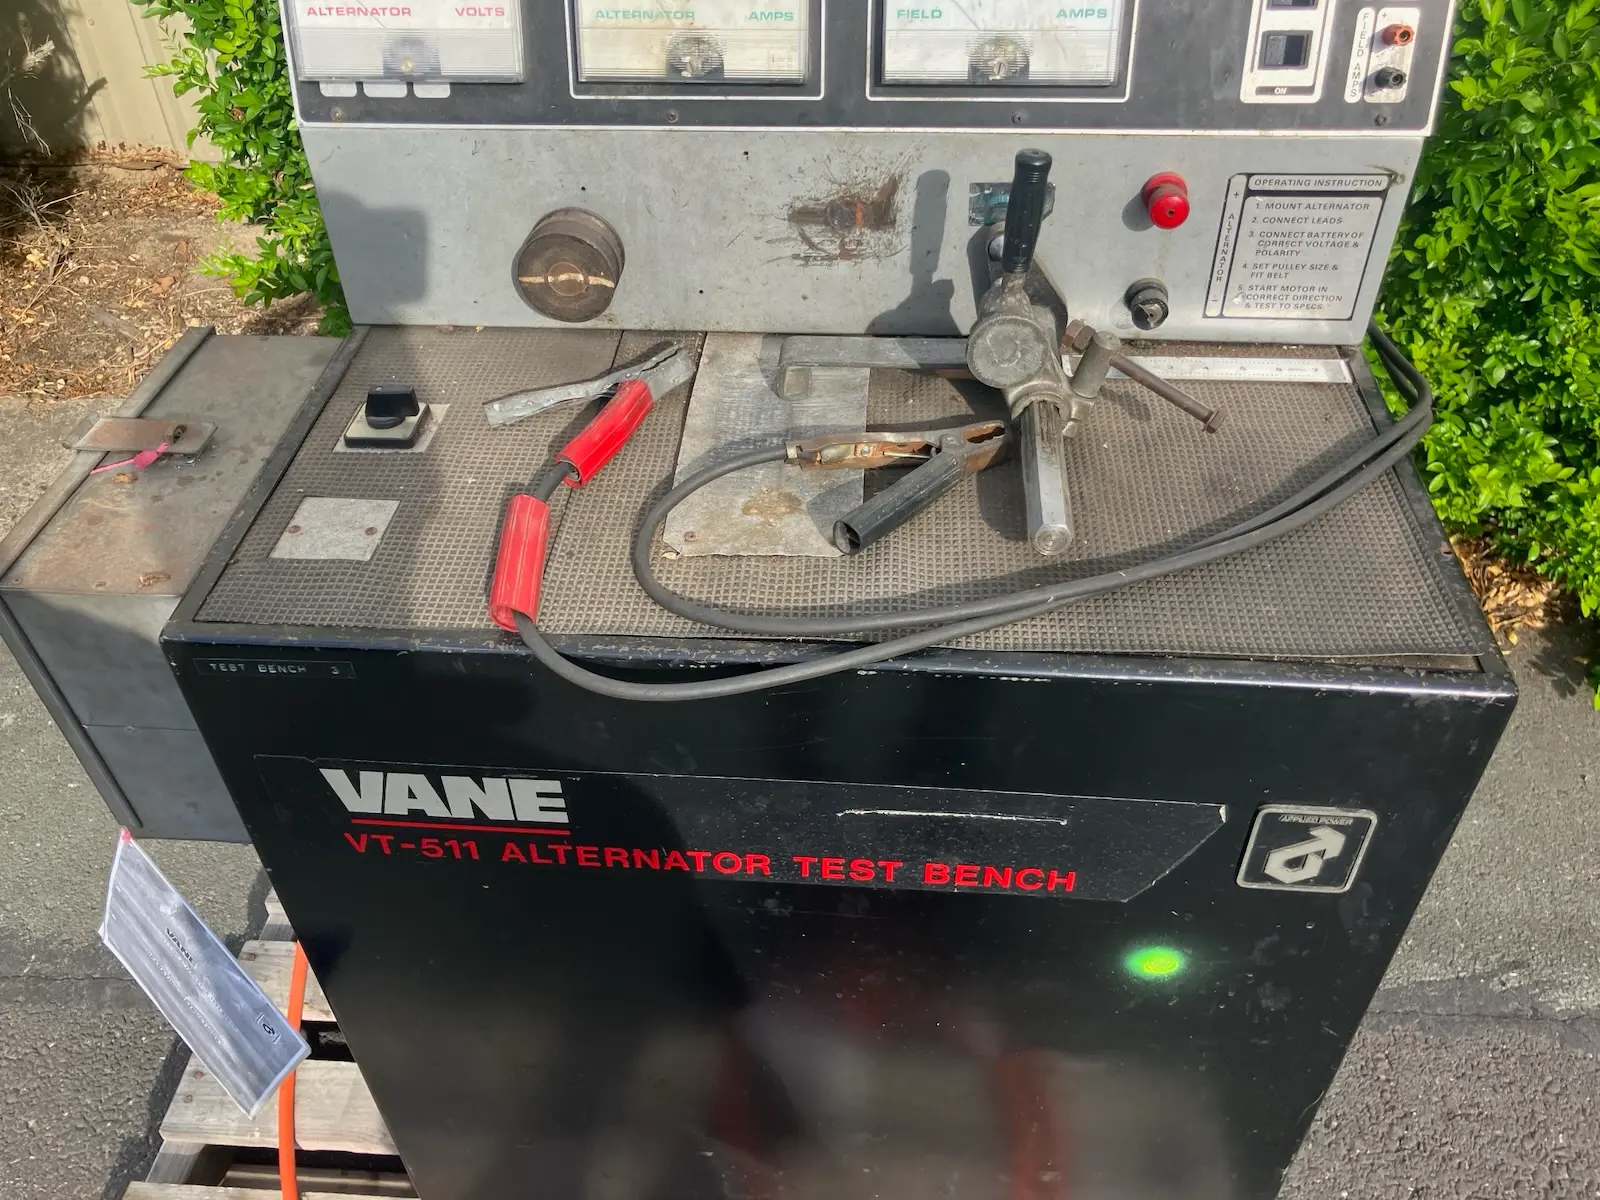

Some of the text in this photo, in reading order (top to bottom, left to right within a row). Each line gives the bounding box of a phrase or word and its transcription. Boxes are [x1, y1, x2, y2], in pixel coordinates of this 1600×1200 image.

[307, 6, 412, 17] ALTERNATOR
[455, 7, 505, 17] VOLTS
[595, 9, 695, 20] ALTERNATOR
[748, 11, 794, 21] AMPS
[896, 9, 942, 19] FIELD
[1056, 8, 1108, 19] AMPS
[1350, 12, 1370, 98] FIELD AMPS
[1274, 87, 1287, 95] ON
[1254, 178, 1383, 187] OPERATING INSTRUCTION
[1259, 231, 1305, 239] CONNECT
[1307, 231, 1350, 239] BATTERY
[1257, 240, 1303, 248] CORRECT
[1280, 285, 1316, 293] MOTOR
[209, 663, 340, 675] TEST BENCH 3
[319, 768, 570, 824] VANE
[1279, 814, 1354, 825] APPLIED POWER
[344, 832, 1077, 892] VT-511 ALTERNATOR TEST BENCH
